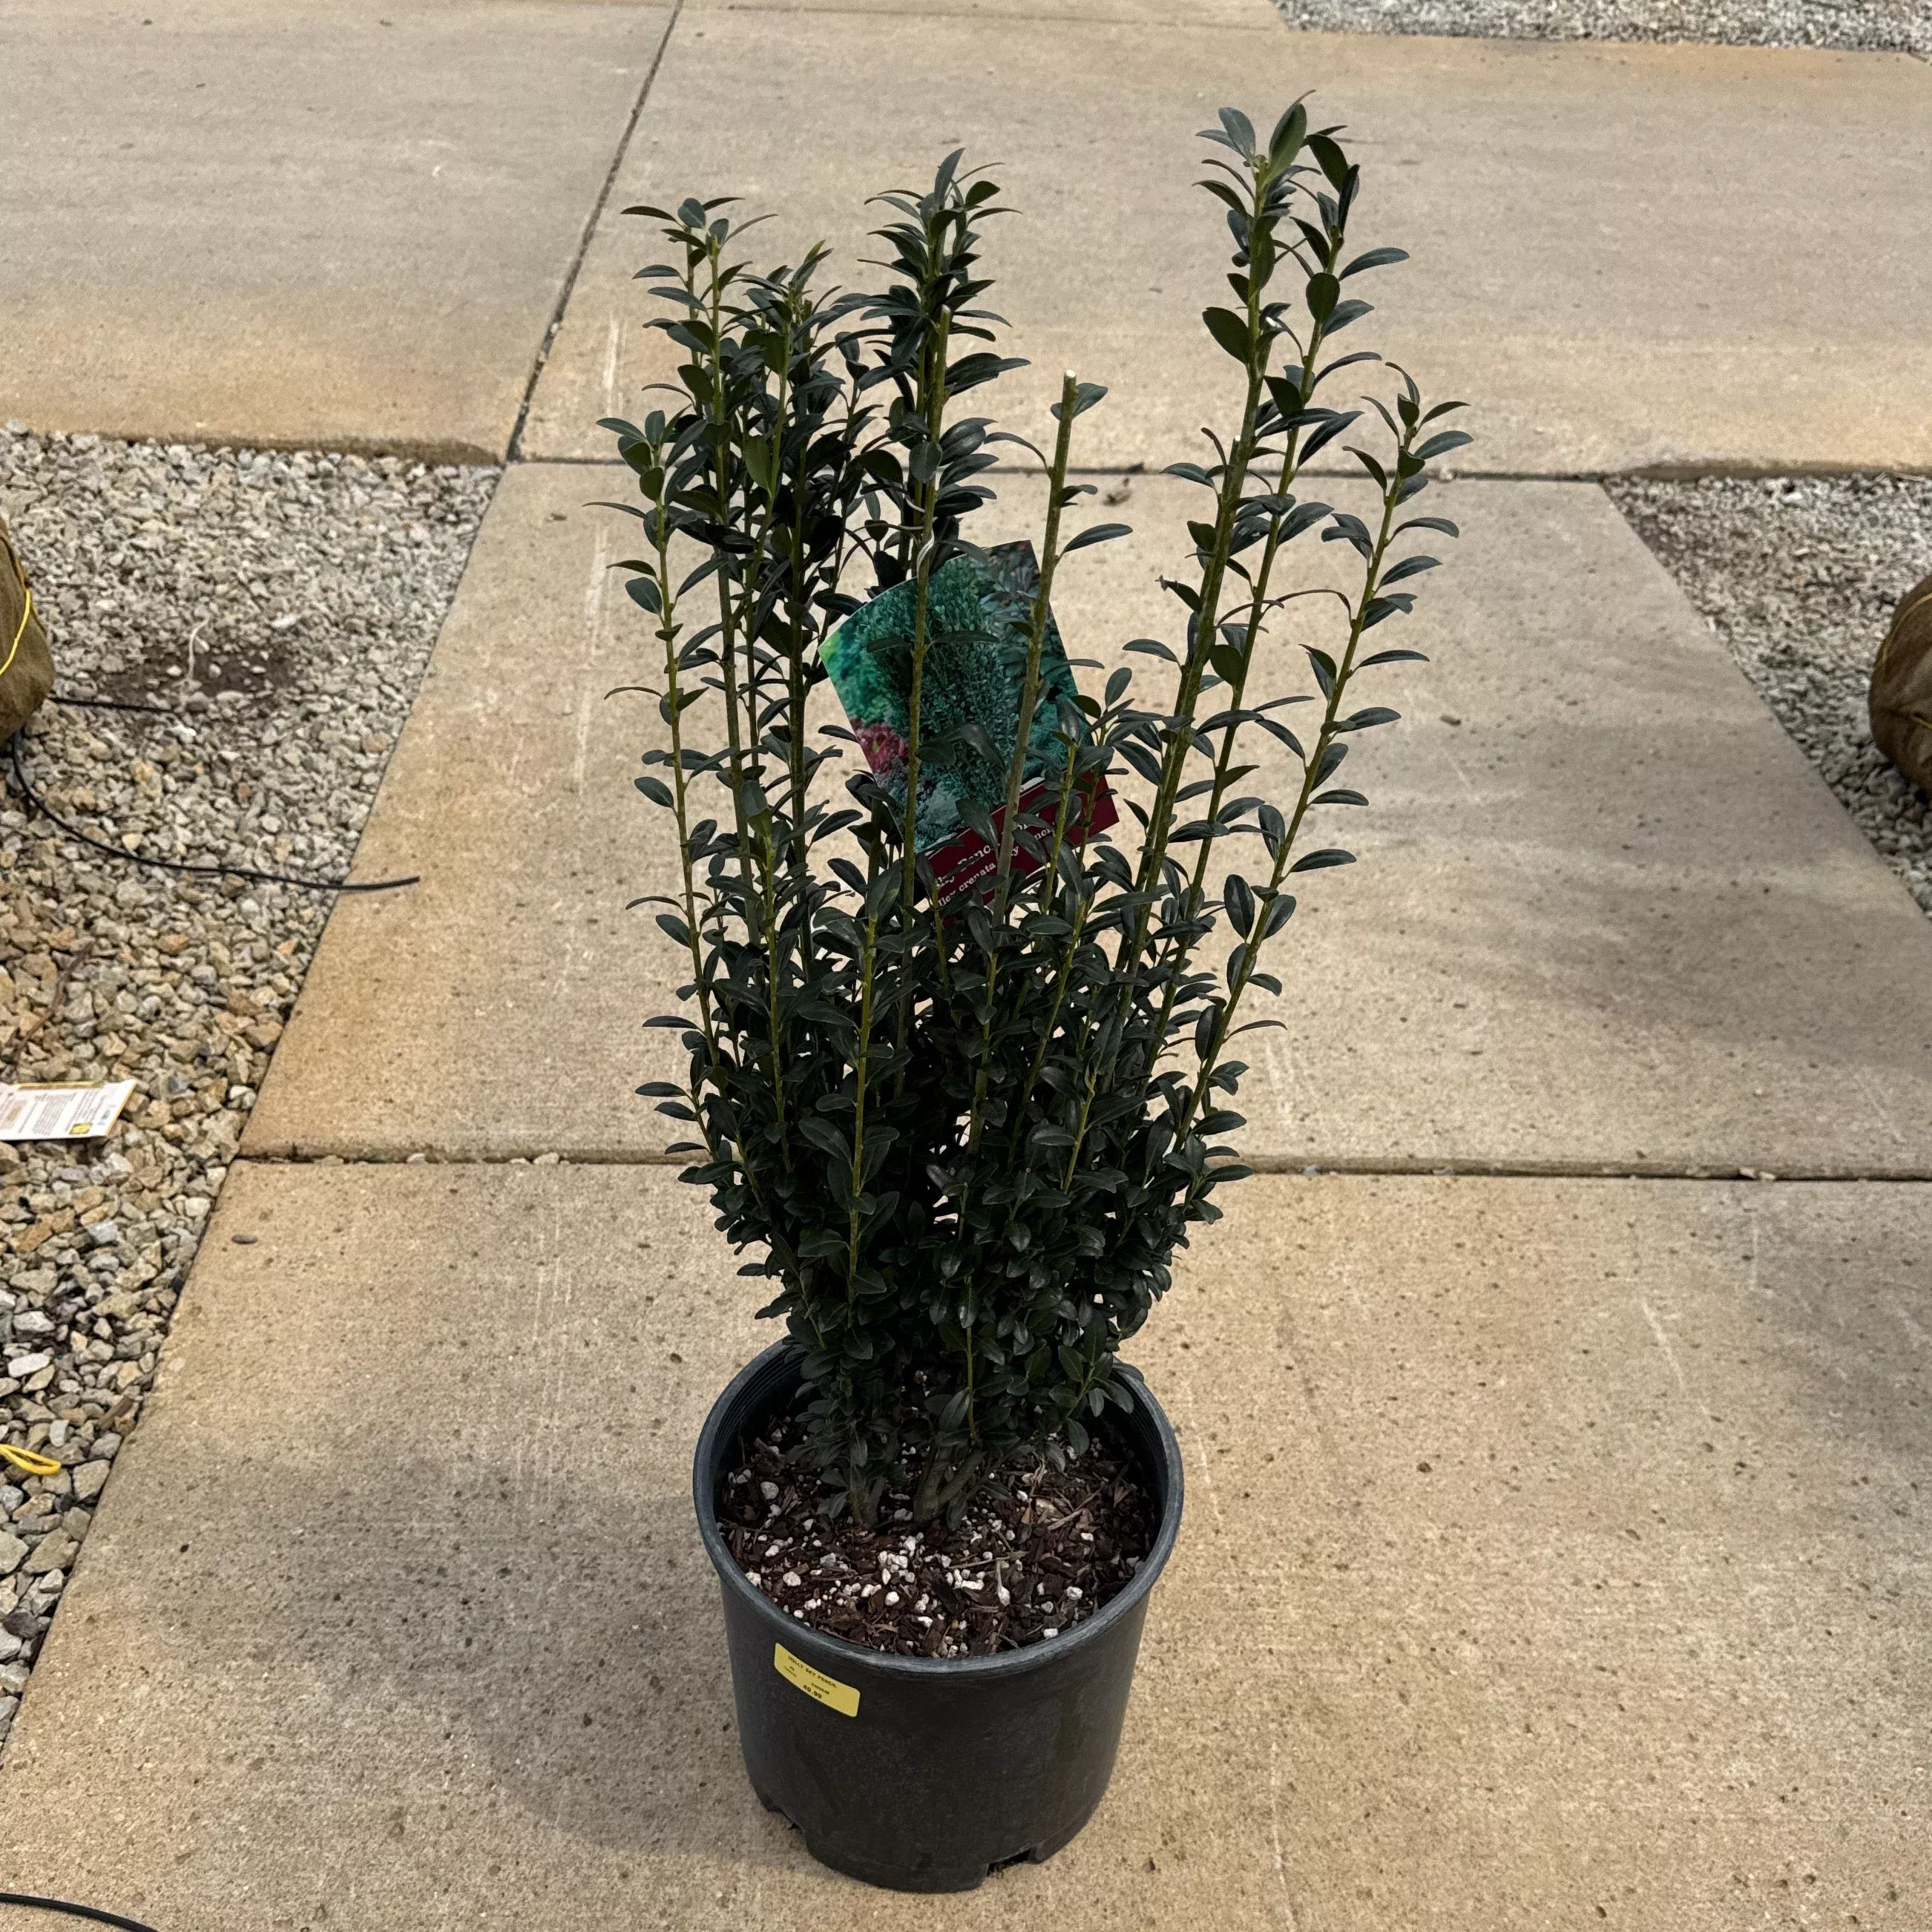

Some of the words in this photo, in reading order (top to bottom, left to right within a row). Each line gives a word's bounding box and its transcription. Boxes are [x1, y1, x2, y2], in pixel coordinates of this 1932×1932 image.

[788, 1655, 804, 1669] HOLLY
[818, 1675, 837, 1689] PENCIL
[803, 1684, 822, 1699] 49.99
